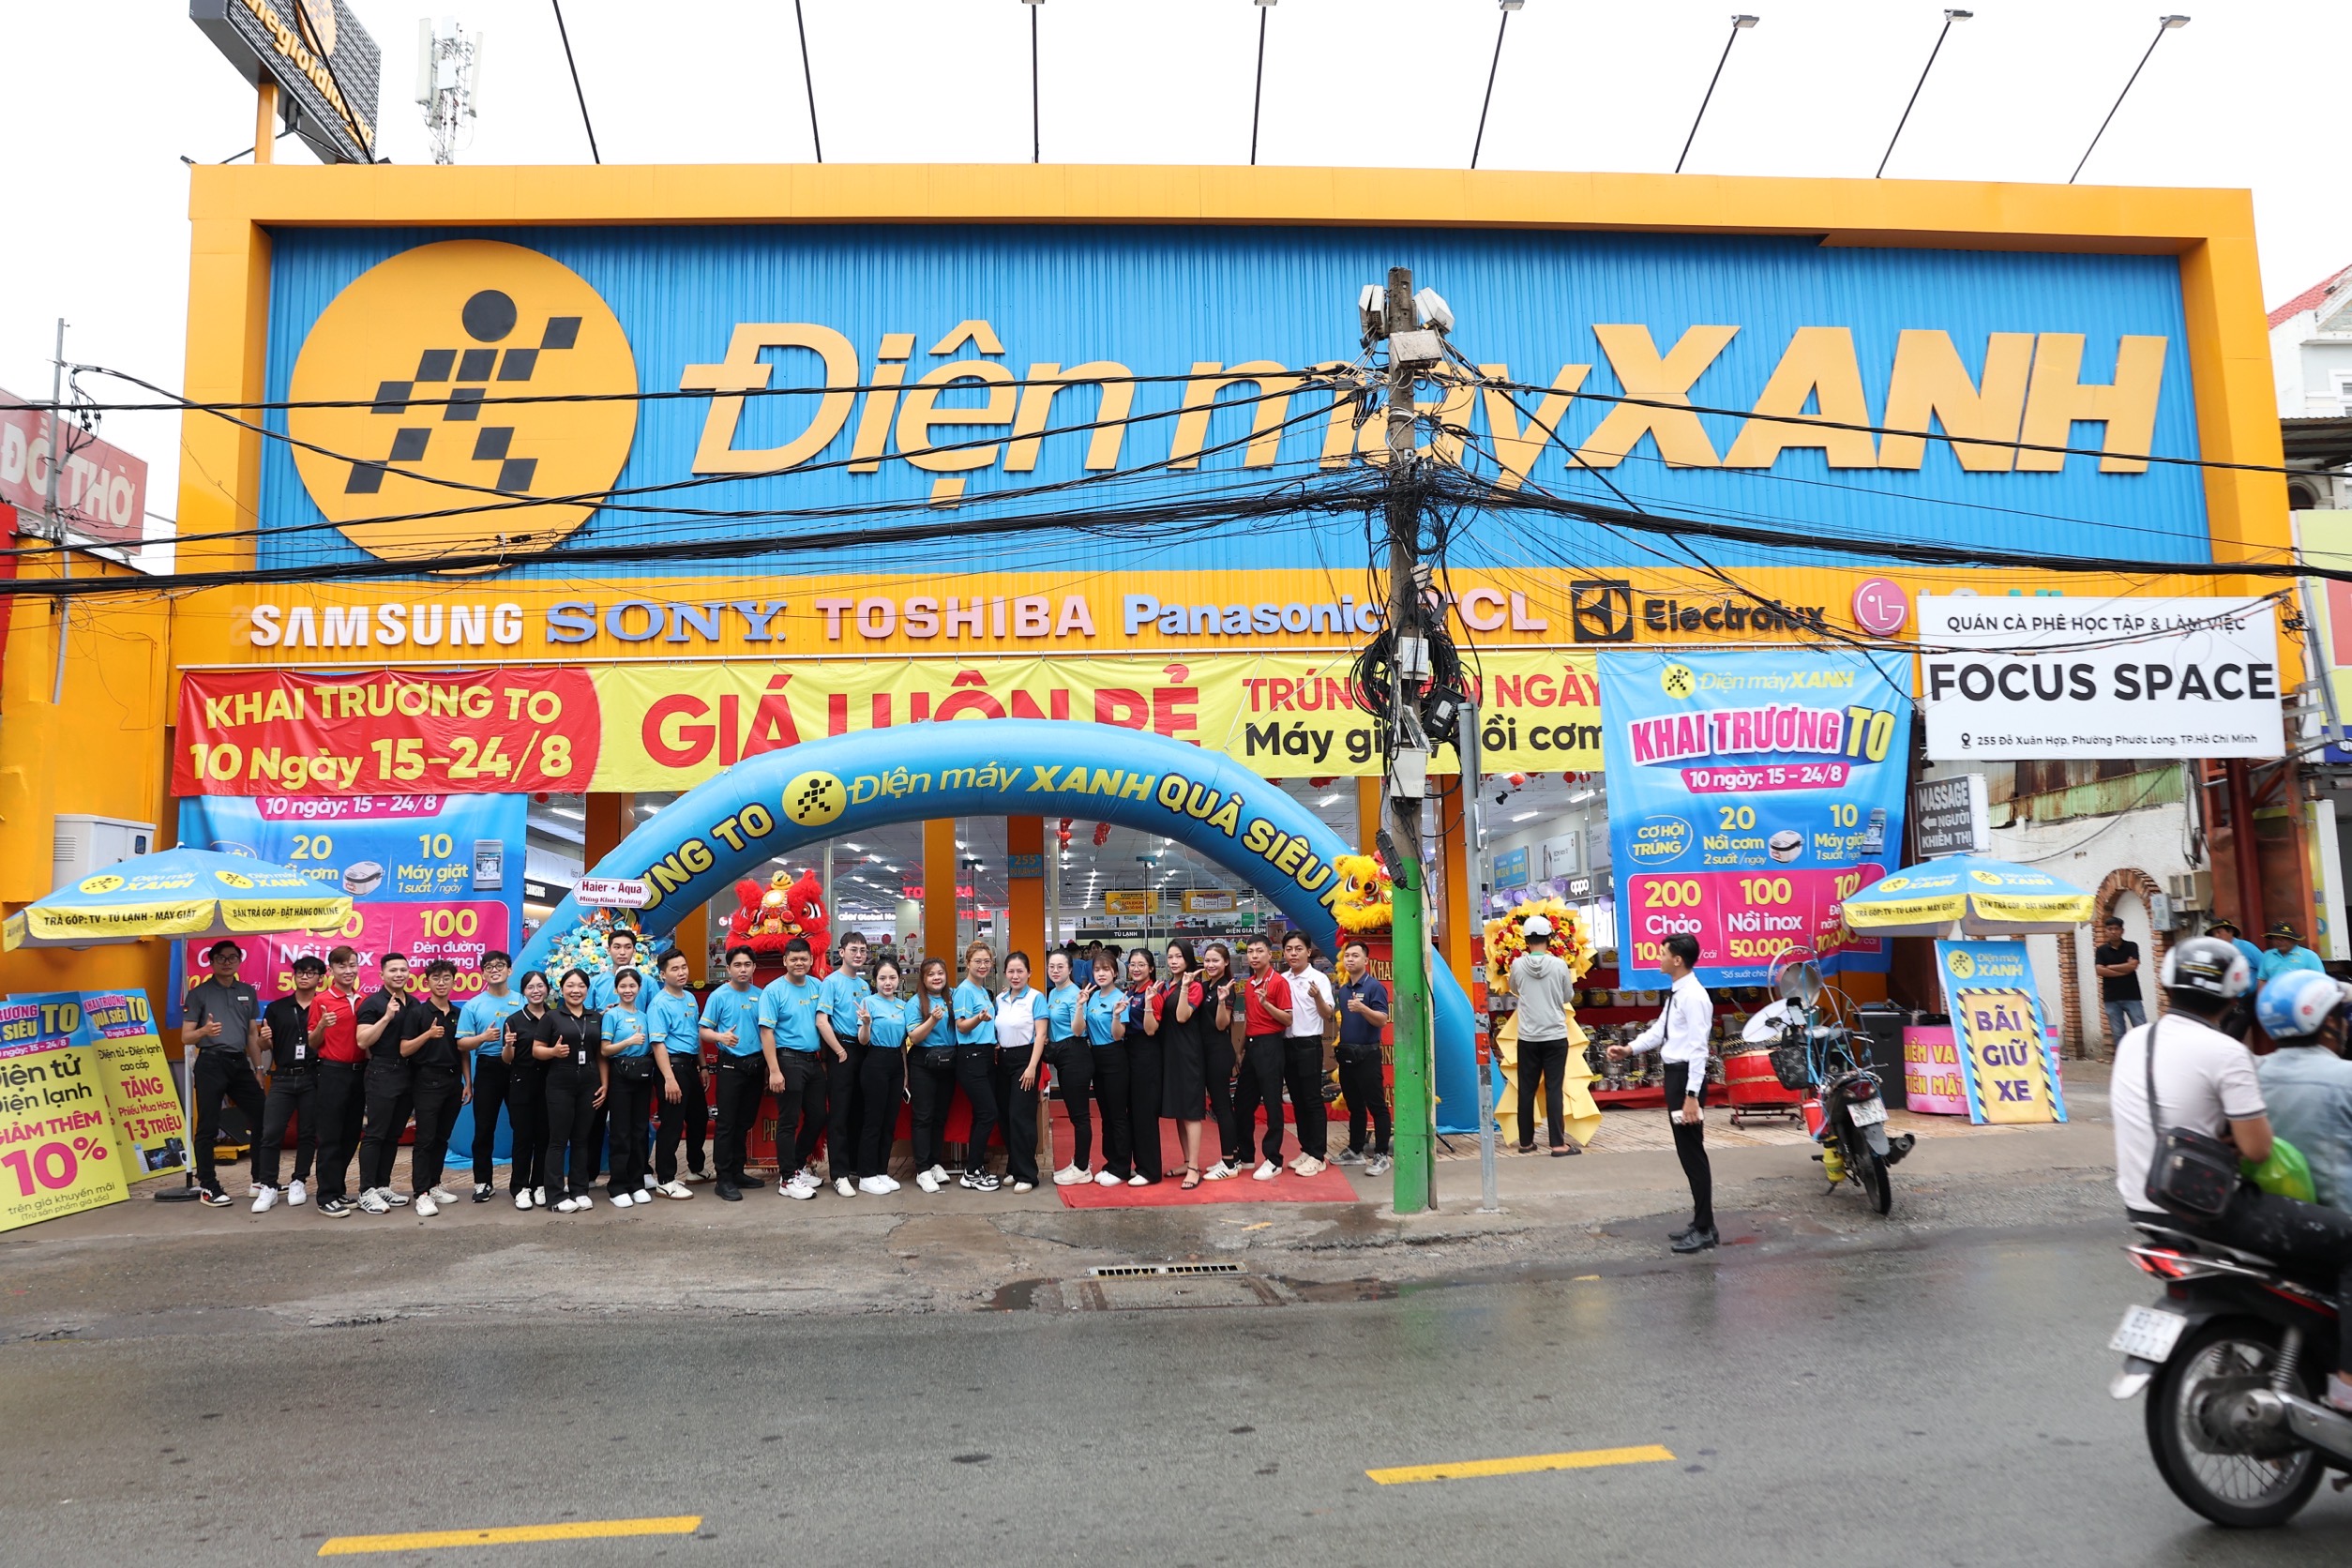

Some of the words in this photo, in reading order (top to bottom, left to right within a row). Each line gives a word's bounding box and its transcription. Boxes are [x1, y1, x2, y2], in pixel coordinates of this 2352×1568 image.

[678, 320, 1135, 509] Điện
[1565, 324, 2169, 474] XANH
[250, 603, 523, 646] SAMSUNG
[546, 601, 780, 641] SONY
[816, 596, 1095, 639] TOSHIBA
[1123, 595, 1385, 635] Panasonic
[1947, 614, 1998, 632] QUÁN
[2003, 614, 2027, 631] CÀ
[2034, 614, 2066, 631] PHÊ
[2072, 617, 2108, 635] HỌC
[2113, 613, 2145, 635] TẬP
[2150, 617, 2160, 631] &
[2166, 613, 2201, 632] LÀM
[1495, 666, 1601, 708] NGÀY
[1699, 671, 1742, 696] Điện
[1747, 671, 1791, 694] máy
[1789, 671, 1855, 688] XANH
[1929, 663, 2097, 701] FOCUS
[2114, 662, 2276, 701] SPACE
[205, 686, 305, 729] KHAI
[314, 681, 492, 719] TRƯƠNG
[505, 687, 562, 723] TO
[641, 674, 800, 768] GIÁ
[1245, 720, 1333, 763] Máy
[1631, 714, 1707, 762] KHAI
[1713, 706, 1841, 751] TRƯƠNG
[1847, 706, 1896, 761] TO
[1977, 736, 1997, 746] 255
[2016, 735, 2043, 746] Xuân
[2045, 736, 2070, 749] Hợp,
[2073, 734, 2113, 748] Phường
[2116, 734, 2151, 746] Phước
[2152, 734, 2179, 747] Long,
[2231, 733, 2257, 745] Minh
[190, 744, 242, 780] 10
[249, 747, 361, 789] Ngày
[1689, 770, 1711, 787] 10
[1713, 769, 1764, 792] ngày:
[1766, 768, 1786, 785] 15
[1801, 765, 1842, 785] 24/8
[265, 797, 286, 815] 10
[291, 797, 348, 815] ngày:
[354, 796, 371, 813] 15
[390, 795, 437, 814] 24/8
[1919, 781, 1969, 812] MASSAGE
[711, 804, 775, 852] TO
[847, 766, 932, 805] Điện
[940, 761, 1022, 793] máy
[1026, 765, 1156, 802] XANH
[1155, 772, 1246, 837] QUÀ
[1241, 815, 1334, 892] SIÊU
[1719, 806, 1756, 830] 20
[1830, 804, 1859, 828] 10
[1937, 811, 1971, 828] NGƯỜI
[1637, 825, 1660, 839] CƠ
[1662, 822, 1685, 839] HỘI
[1703, 834, 1729, 851] Nồi
[1731, 837, 1765, 850] cơm
[1815, 833, 1845, 852] Máy
[1955, 830, 1973, 847] THỊ
[290, 835, 333, 860] 20
[418, 833, 453, 859] 10
[1633, 839, 1681, 857] TRÚNG
[1712, 852, 1739, 865] suất
[124, 879, 195, 892] XANH
[254, 878, 309, 887] XANH
[301, 868, 339, 880] cơm
[398, 865, 434, 884] Máy
[436, 864, 469, 882] giặt
[2006, 877, 2054, 886] XANH
[582, 881, 608, 892] Haier
[618, 882, 642, 895] Aqua
[1644, 880, 1702, 908] 200
[1739, 878, 1792, 905] 100
[44, 912, 64, 926] TRẢ
[65, 915, 87, 925] GÓP:
[89, 915, 101, 924] TV
[122, 913, 148, 924] LẠNH
[155, 911, 174, 921] MÁY
[247, 907, 261, 917] TRẢ
[262, 907, 276, 917] GÓP
[281, 907, 294, 919] ĐẶT
[294, 906, 313, 916] HÀNG
[314, 906, 339, 916] ONLINE
[419, 908, 478, 938] 100
[1645, 912, 1702, 935] Chảo
[1727, 910, 1764, 933] Nồi
[1764, 914, 1803, 932] inox
[1226, 927, 1241, 935] ĐIỆN
[414, 941, 441, 954] Đèn
[443, 940, 486, 955] đường
[1729, 938, 1794, 958] 50.000
[1978, 964, 2024, 976] XANH
[84, 998, 99, 1012] KHAI
[92, 1008, 110, 1028] QUÀ
[111, 1007, 128, 1023] SIÊU
[127, 996, 149, 1022] TO
[3, 1019, 38, 1041] SIÊU
[40, 1003, 80, 1033] TO
[1975, 1004, 2023, 1032] BÃI
[46, 1039, 67, 1049] 24/8
[98, 1049, 115, 1061] Điện
[146, 1045, 162, 1058] lạnh
[1983, 1038, 2028, 1066] GIỮ
[50, 1053, 82, 1078] tử
[120, 1063, 134, 1071] cao
[136, 1059, 150, 1071] cấp
[44, 1082, 93, 1108] lạnh
[121, 1076, 164, 1103] TẶNG
[1994, 1080, 2033, 1102] XE
[118, 1105, 141, 1118] Phiếu
[141, 1102, 158, 1114] Mua
[158, 1100, 177, 1111] Hàng
[46, 1109, 103, 1135] THÊM
[123, 1118, 149, 1141] 1-3
[148, 1113, 183, 1136] TRIỆU
[1, 1137, 108, 1197] 10%
[8, 1203, 32, 1215] trên
[36, 1197, 53, 1213] giá
[55, 1187, 94, 1208] khuyến
[96, 1182, 116, 1193] mãi
